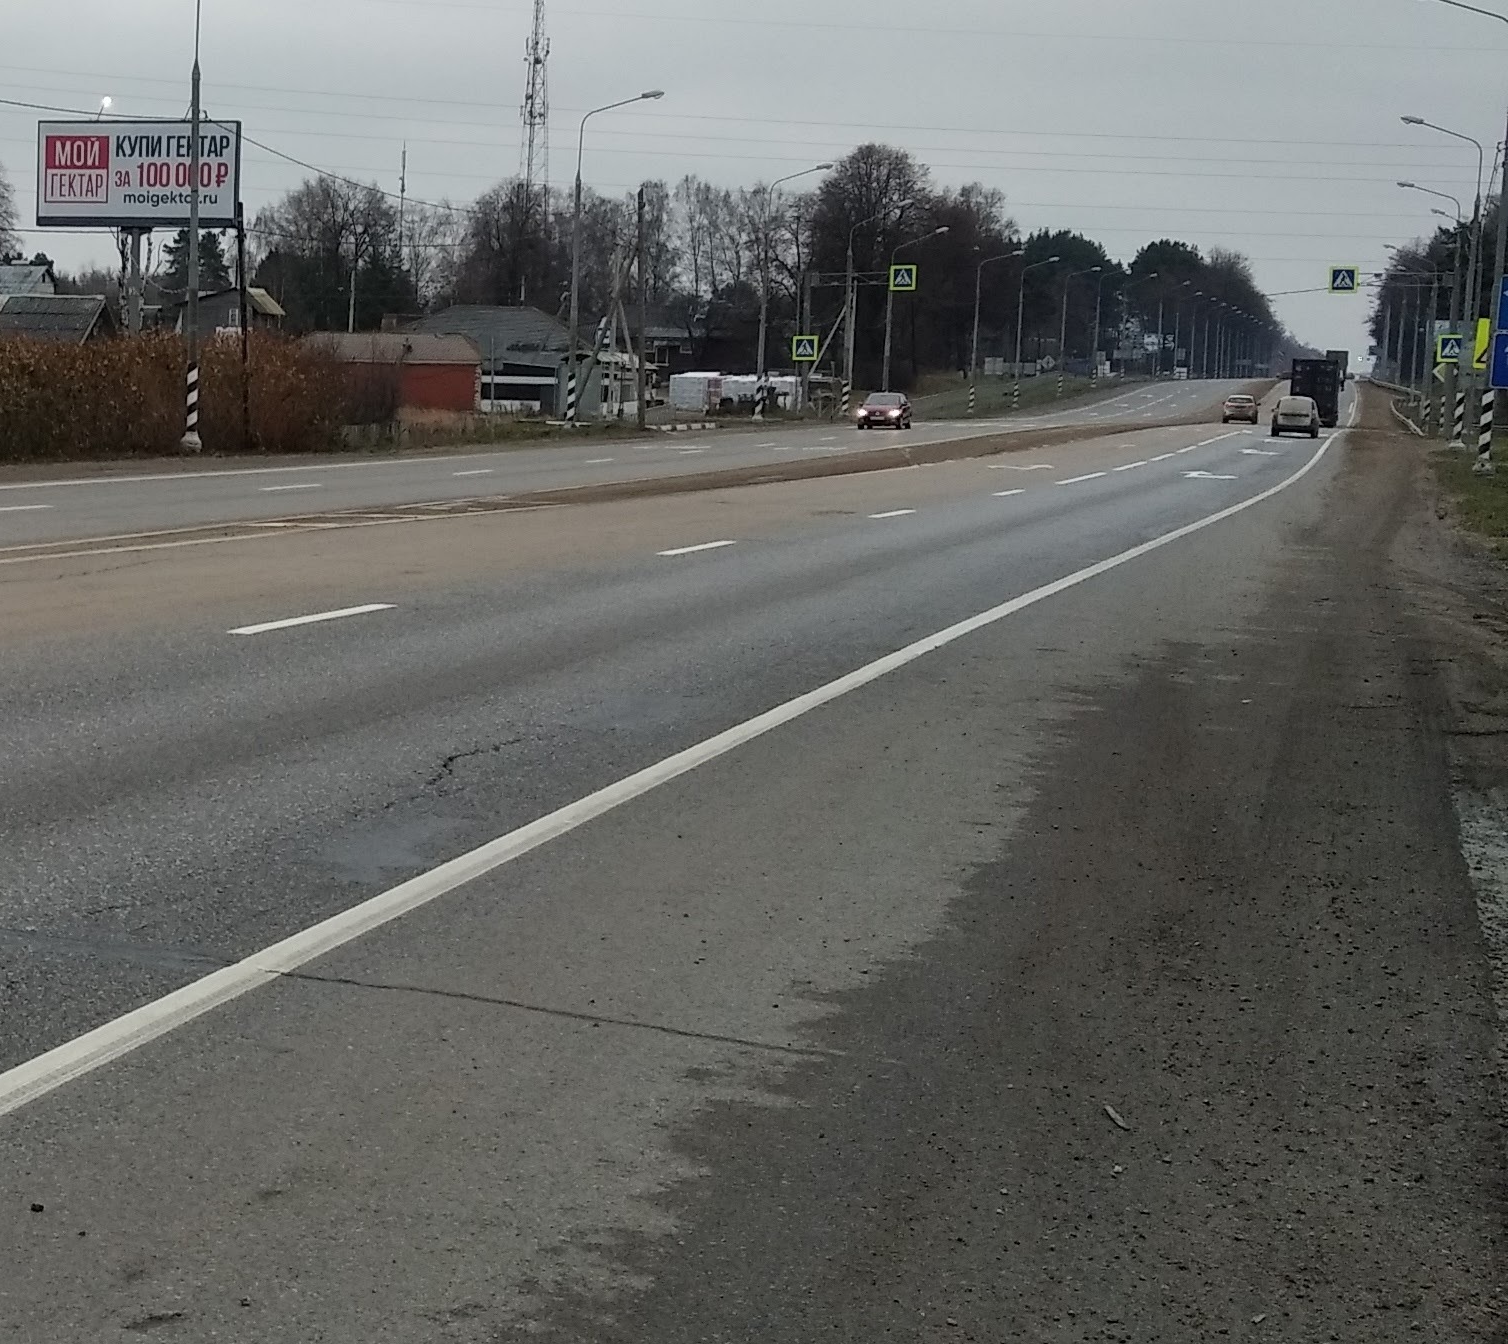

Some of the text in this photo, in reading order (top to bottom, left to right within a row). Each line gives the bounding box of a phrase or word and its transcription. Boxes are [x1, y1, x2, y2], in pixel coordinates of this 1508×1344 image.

[55, 137, 100, 166] МОЙ
[115, 135, 162, 157] КУПИ
[50, 173, 103, 198] ГЕКТАР
[115, 170, 131, 187] ЗА
[123, 190, 218, 207] moigekta.ru
